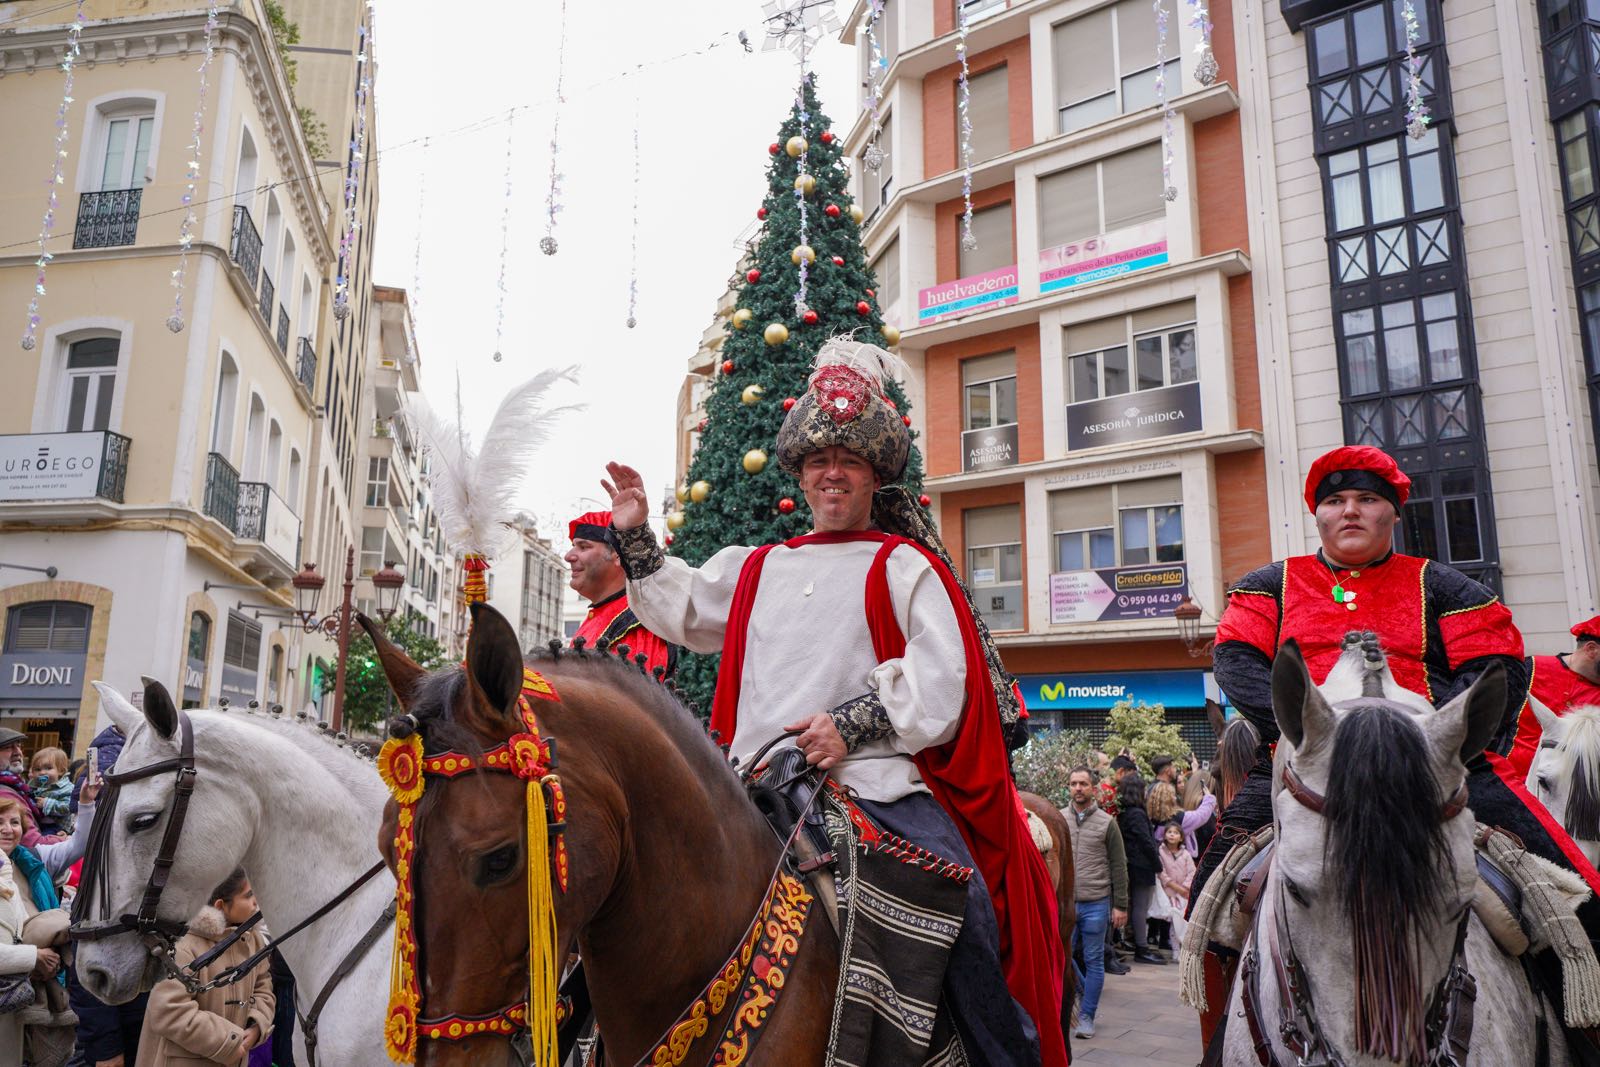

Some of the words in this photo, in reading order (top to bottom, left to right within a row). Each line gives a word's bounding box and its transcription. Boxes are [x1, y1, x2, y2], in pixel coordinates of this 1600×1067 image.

[1058, 264, 1094, 277] Francisco
[1094, 259, 1105, 268] de
[1105, 257, 1114, 265] la
[926, 273, 1015, 306] huelvaderm
[1083, 418, 1132, 435] ASESORÍA
[1136, 409, 1185, 428] JURÍDICA
[969, 442, 1012, 457] ASESORÍA
[971, 452, 1011, 467] JURÍDICA
[1117, 571, 1182, 585] CreditGestión
[1130, 596, 1145, 605] 959
[1147, 595, 1158, 604] 04
[1159, 594, 1170, 603] 42
[1171, 593, 1182, 602] 49
[10, 663, 73, 685] DIONI
[1067, 683, 1126, 698] movistar
